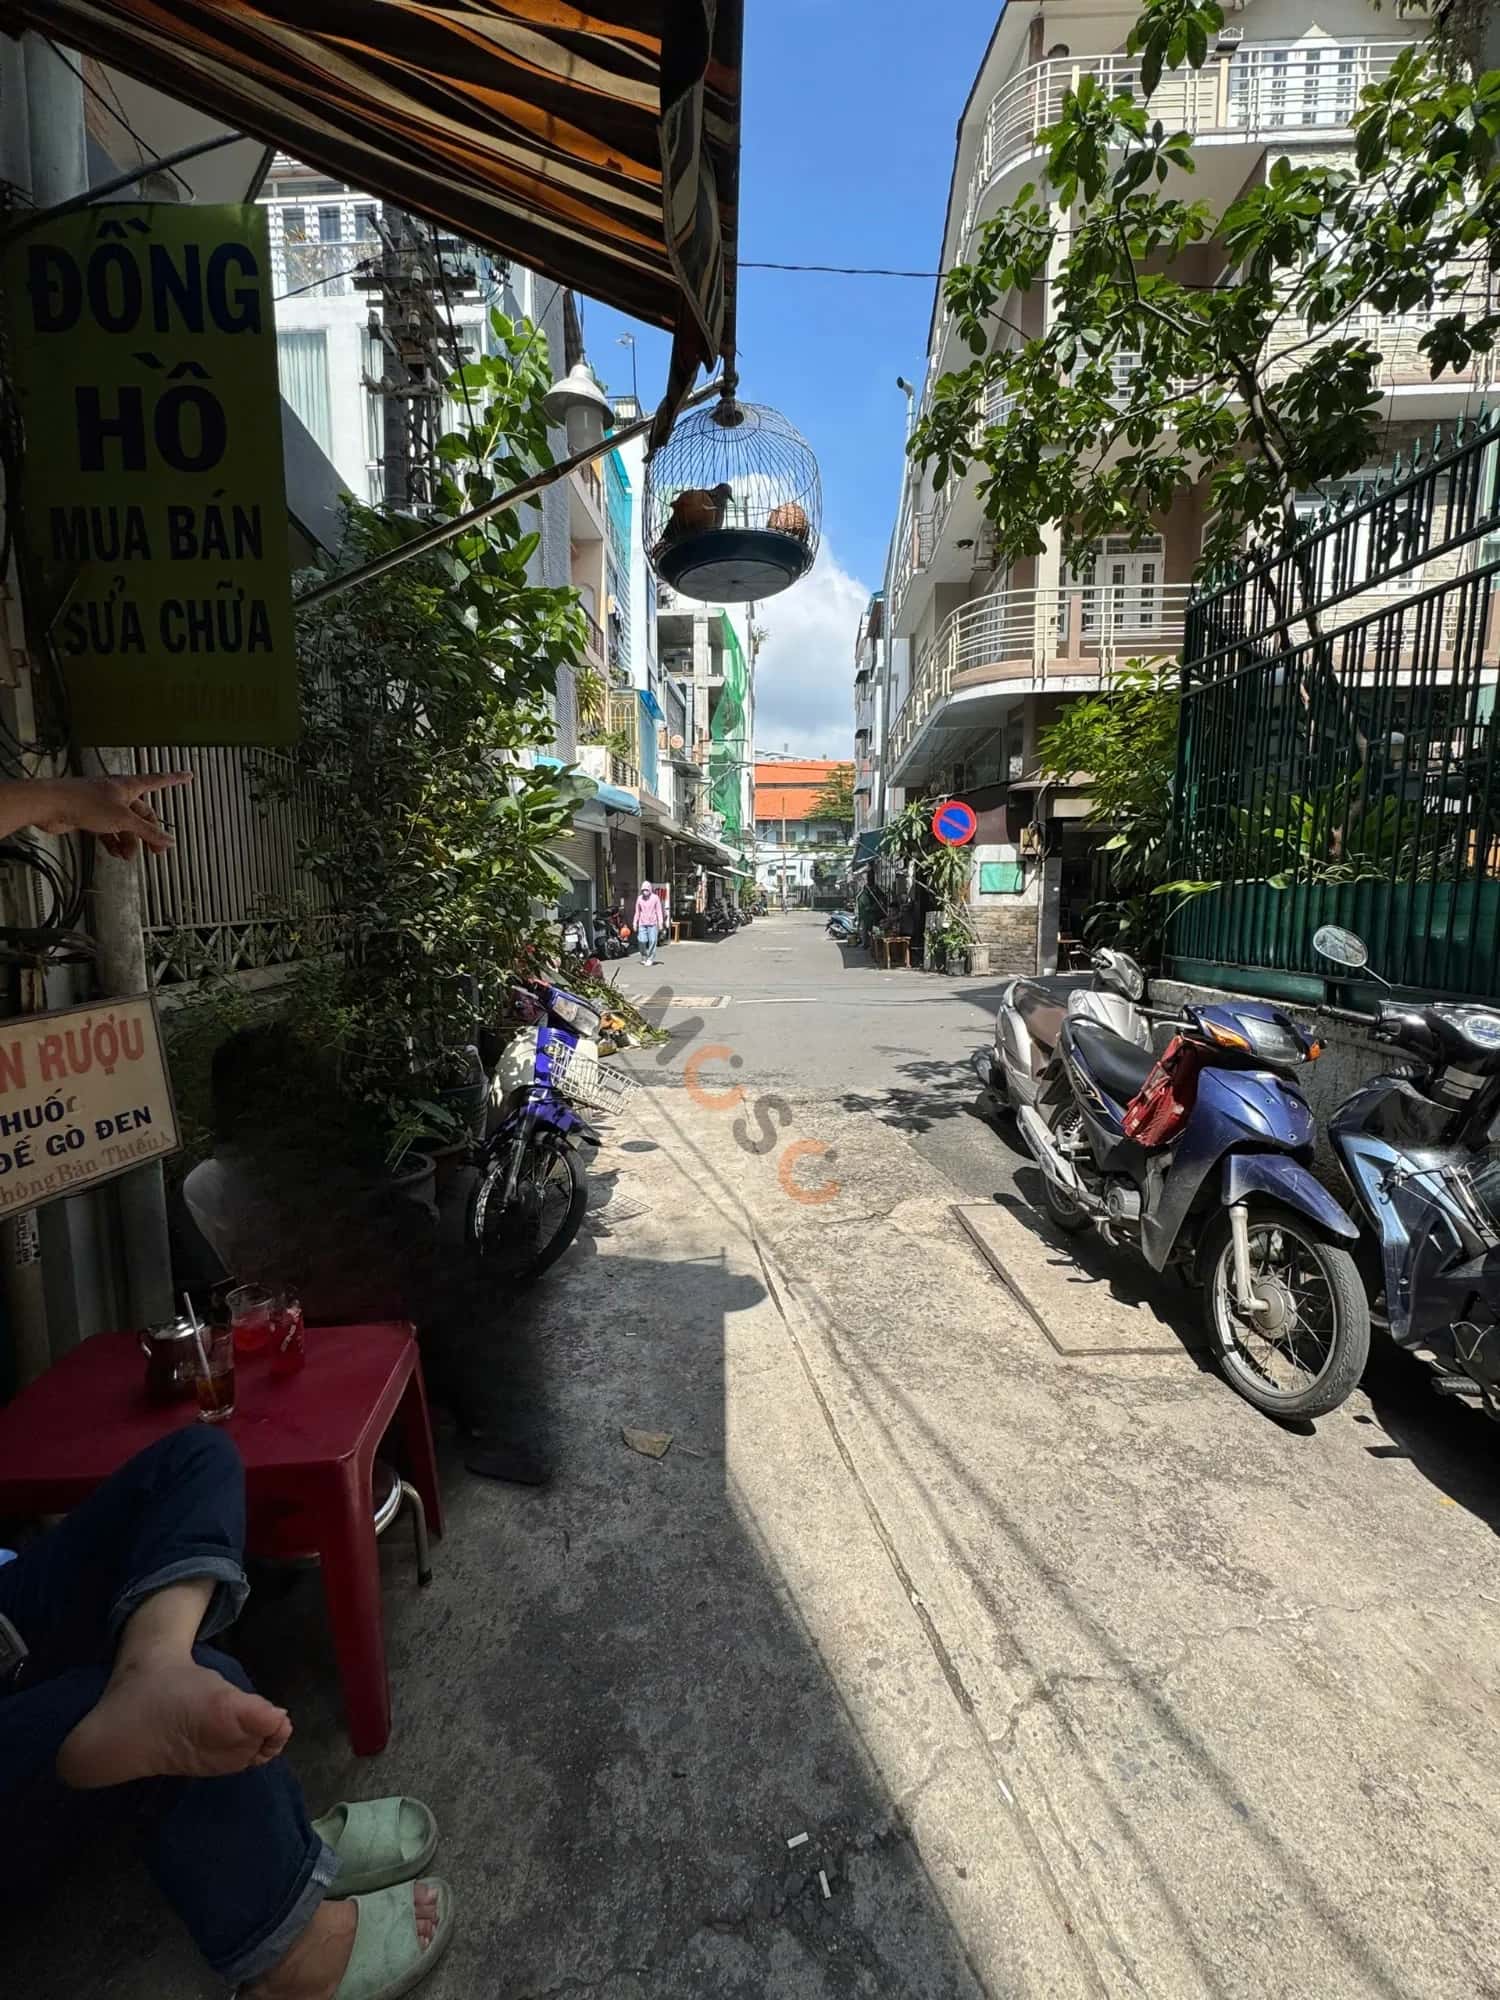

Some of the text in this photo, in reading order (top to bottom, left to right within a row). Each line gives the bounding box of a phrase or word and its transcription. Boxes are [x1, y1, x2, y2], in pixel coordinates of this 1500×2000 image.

[27, 218, 262, 334] ĐỒNG
[75, 352, 227, 472] HỒ
[50, 489, 263, 561] MUA BÁN
[64, 575, 274, 655] SỬA CHỮA
[38, 1013, 145, 1082] RƯỢU
[46, 1124, 85, 1156] GÒ
[95, 1105, 152, 1141] ĐEN
